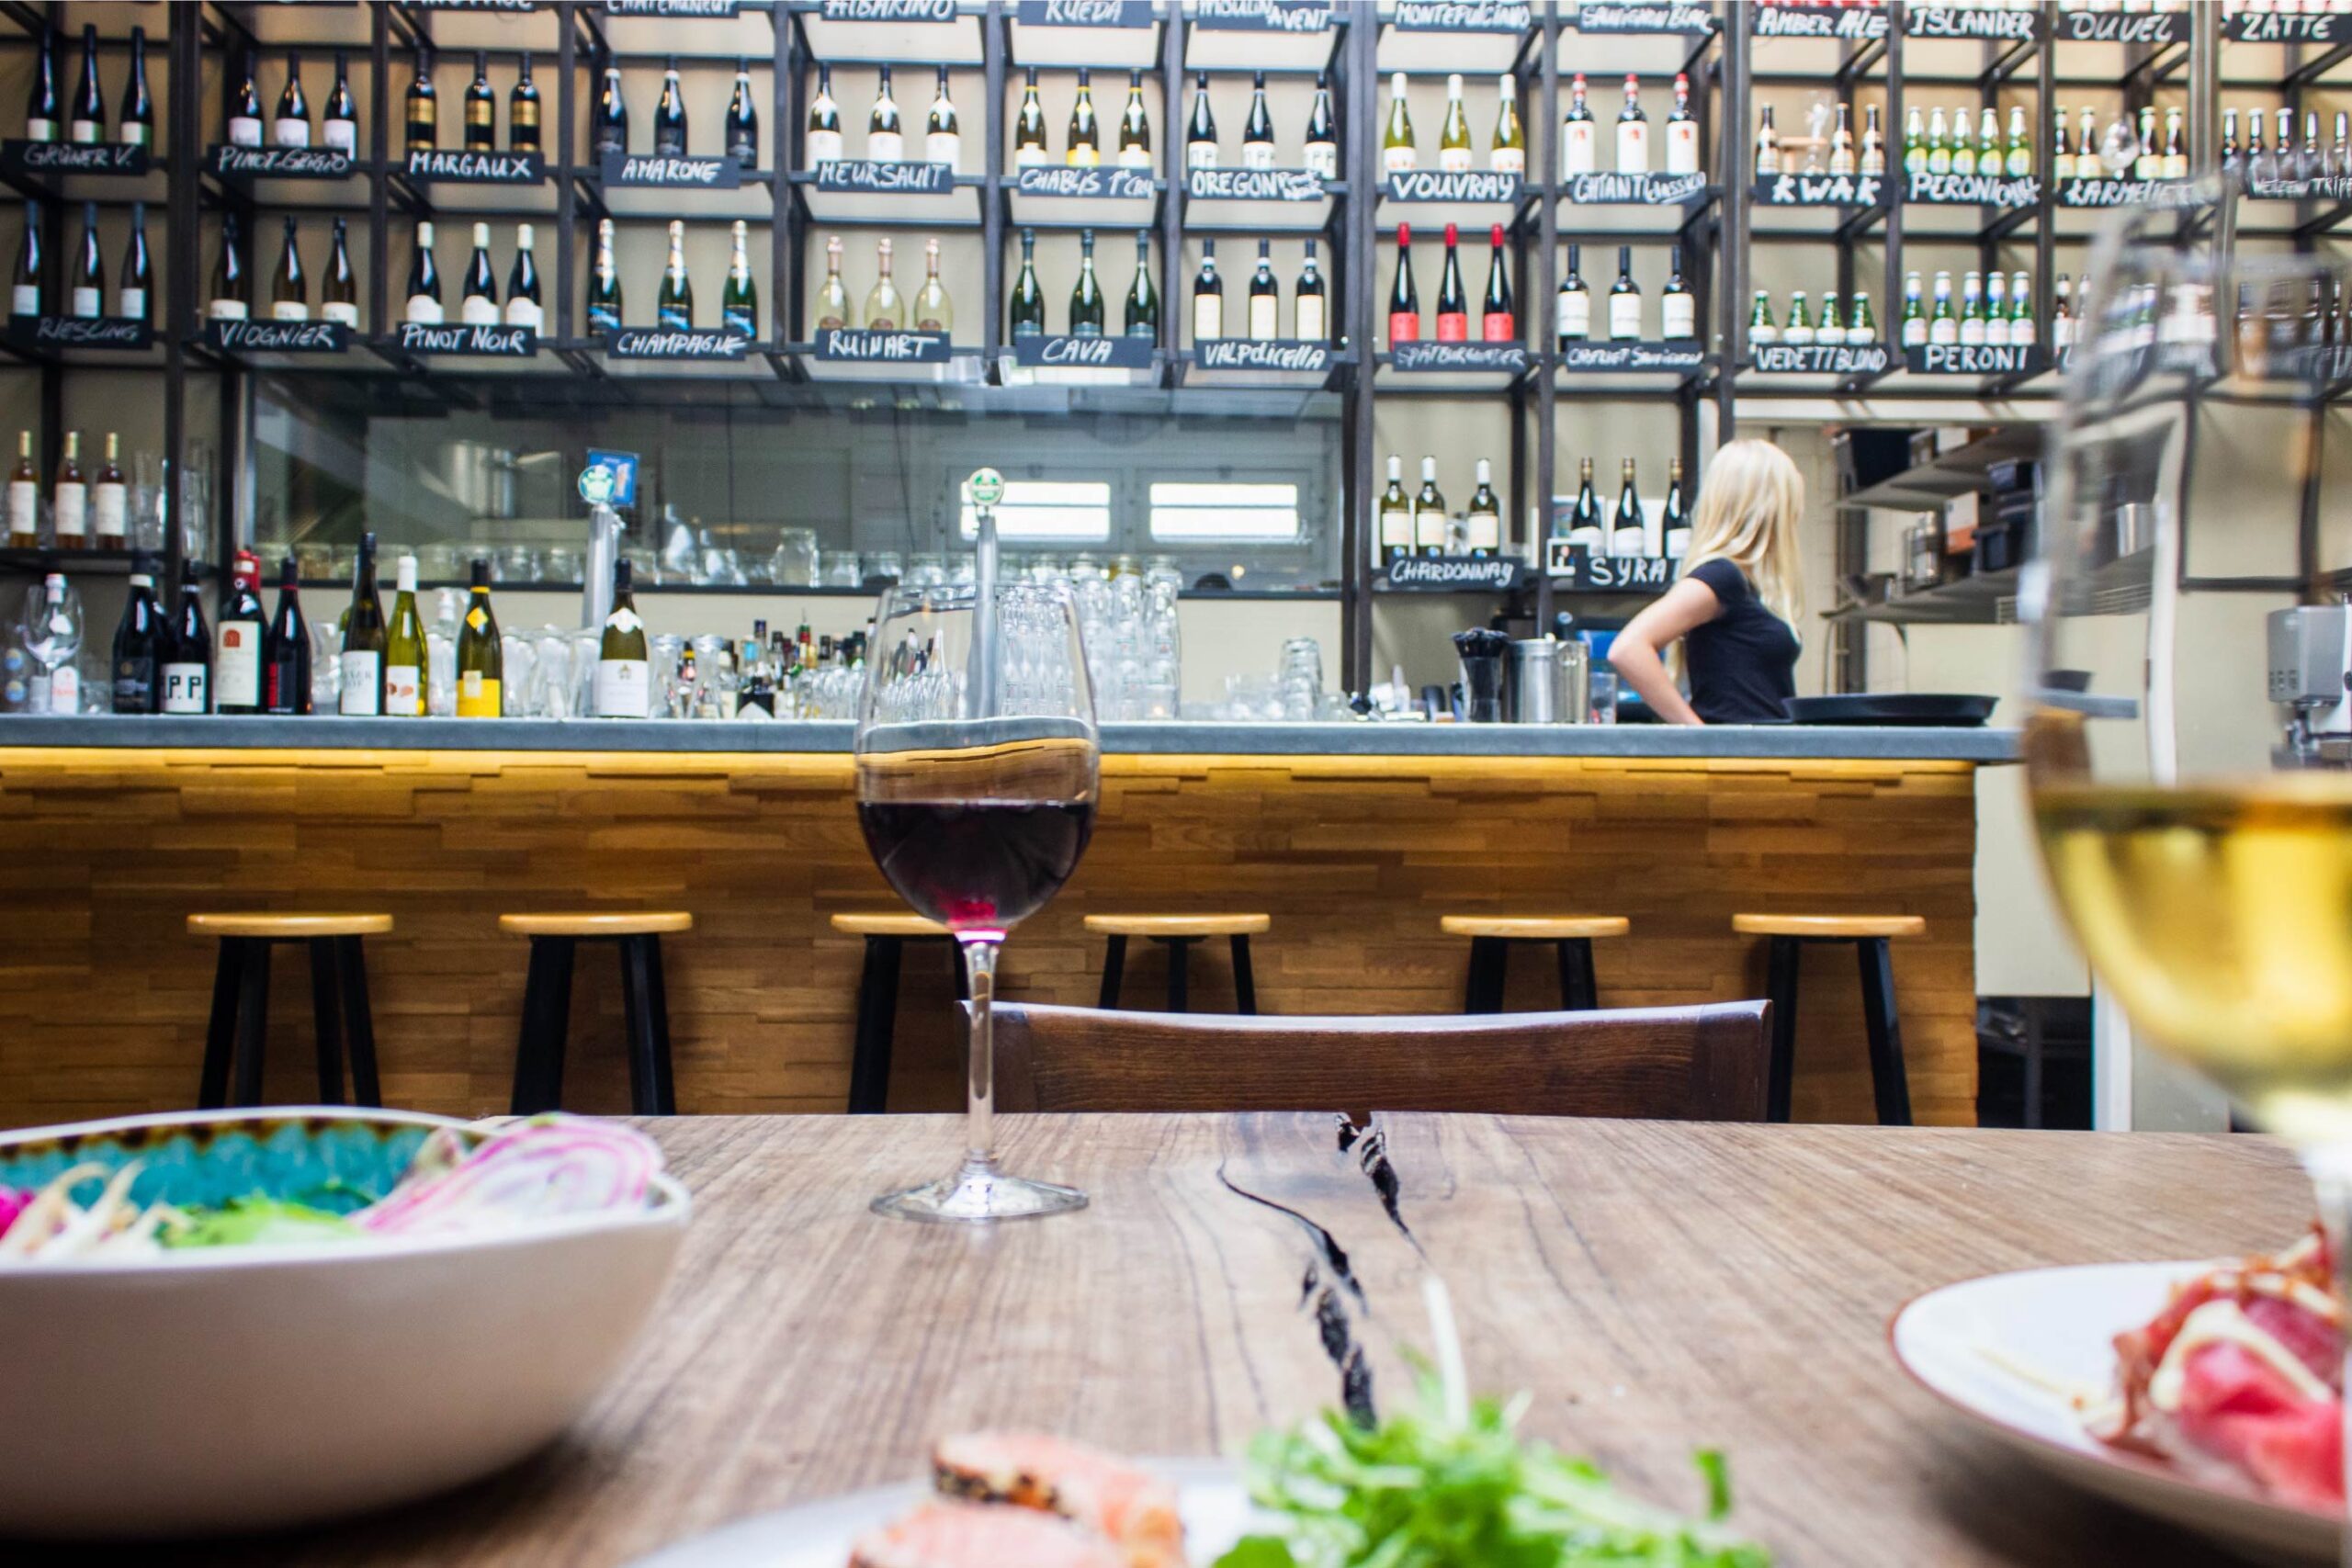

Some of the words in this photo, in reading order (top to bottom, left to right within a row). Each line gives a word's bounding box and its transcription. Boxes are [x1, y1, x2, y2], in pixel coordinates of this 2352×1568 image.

[1758, 7, 1833, 36] AMBER
[1835, 9, 1889, 39] ALE
[1908, 8, 2034, 41] ISLANDER
[2068, 12, 2174, 43] DUVEL
[2241, 13, 2336, 40] ZATTE
[409, 151, 533, 178] MARGAUX
[621, 158, 722, 184] AMARONE
[1192, 170, 1278, 198] OREGON
[1392, 173, 1515, 202] VOUVRAY
[1771, 175, 1882, 207] KWAK
[37, 317, 139, 341] RIESLING
[401, 323, 467, 350] PINOT
[470, 324, 526, 355] NOIR
[617, 333, 748, 356] CHAMPAGNE
[1041, 338, 1114, 364] CAVA
[1925, 344, 2028, 372] PERONI
[1390, 559, 1514, 588] CHARDONNAY
